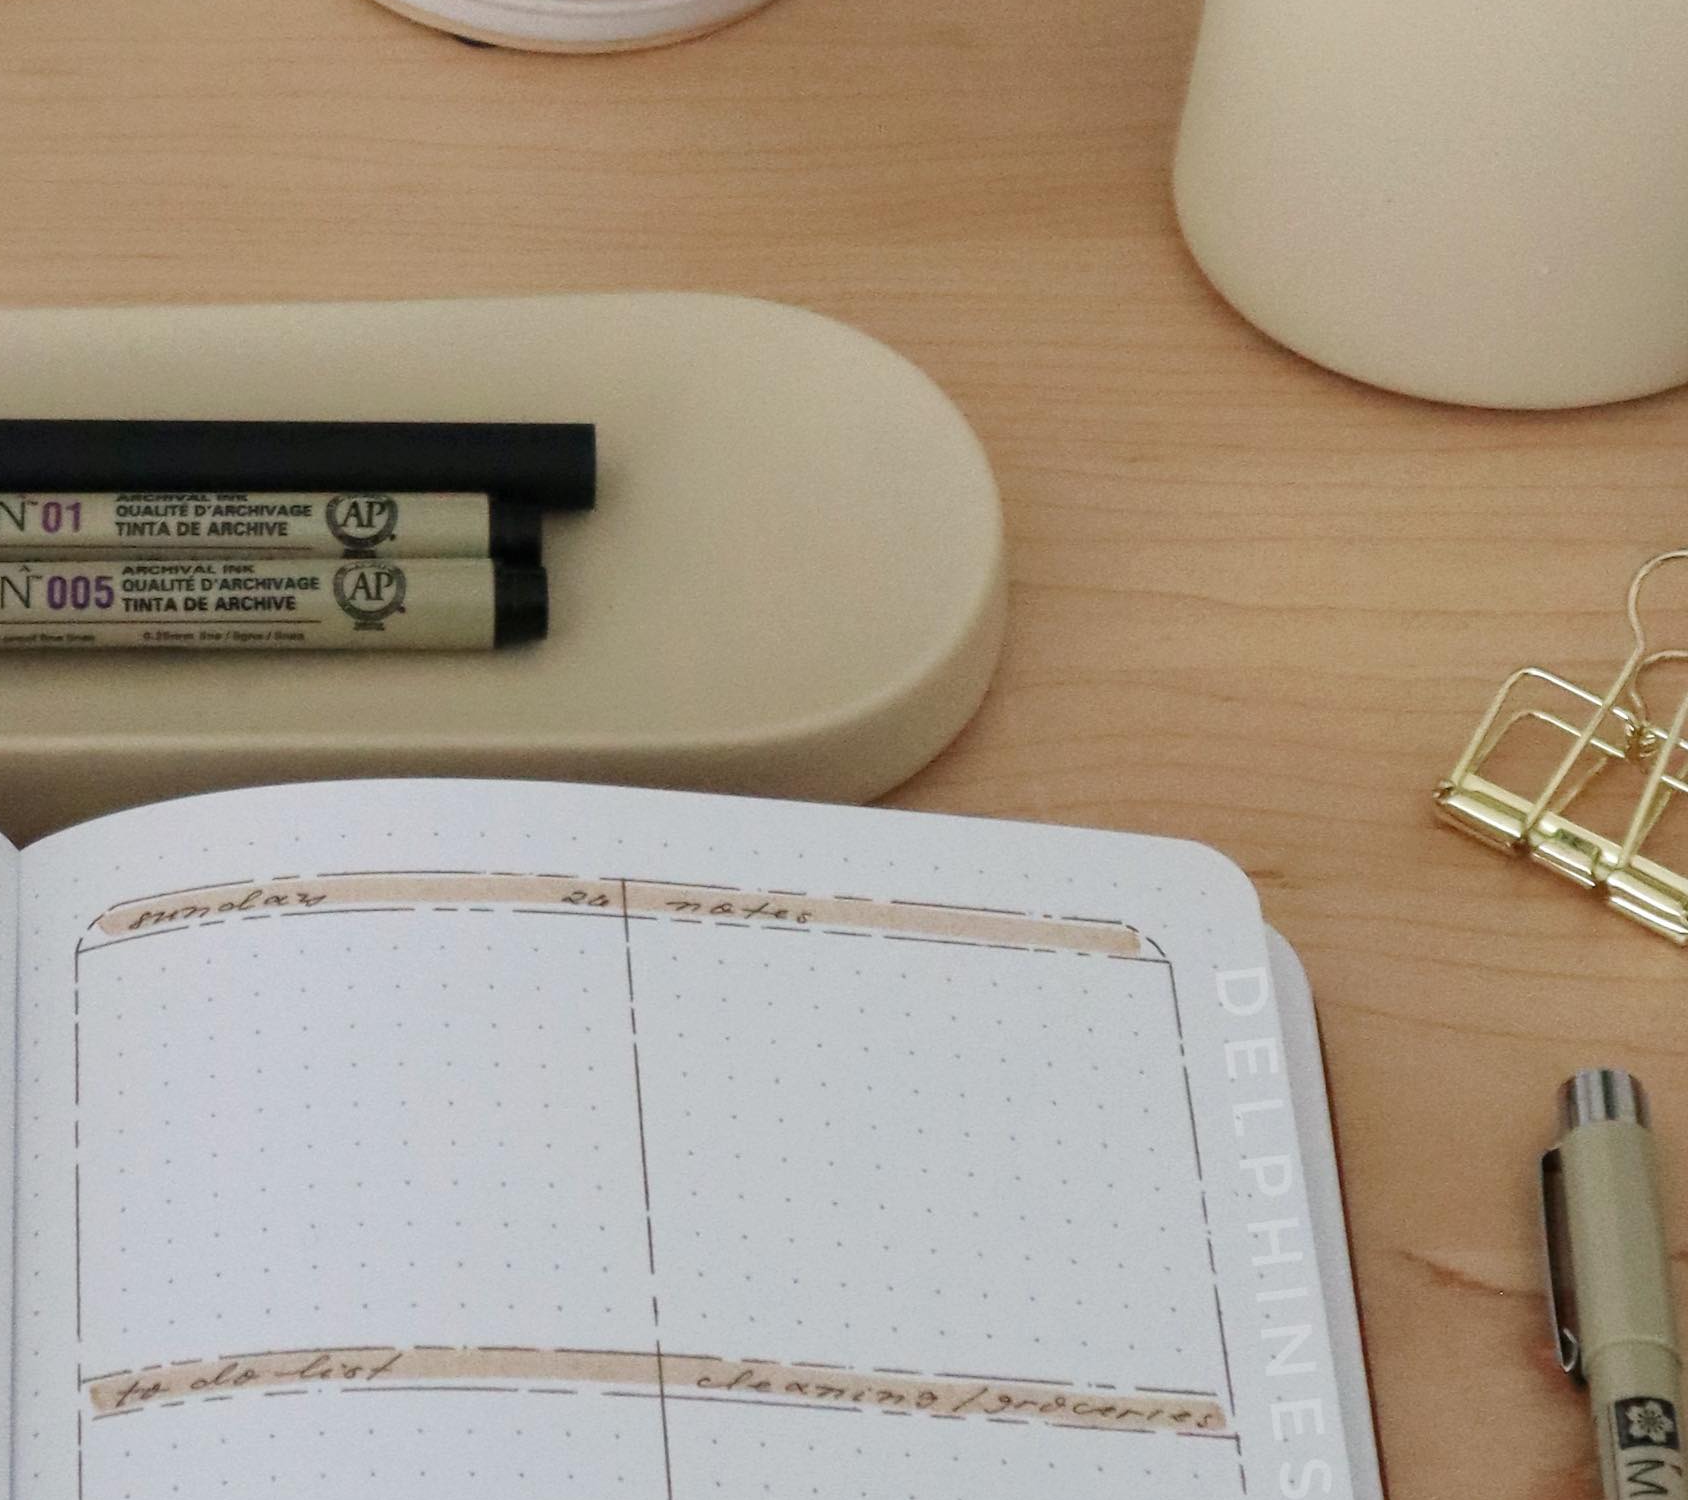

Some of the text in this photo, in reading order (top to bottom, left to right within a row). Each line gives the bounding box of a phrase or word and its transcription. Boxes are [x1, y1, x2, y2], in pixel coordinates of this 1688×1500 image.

[41, 501, 82, 534] 01
[115, 503, 312, 518] QUALITÉ D'ARCHIVAGE
[115, 521, 288, 537] TINTA DE ARCHIVE
[122, 565, 255, 575] ARCHIVAL INK
[47, 575, 114, 610] 005
[122, 575, 320, 592] QUALITÉ D'ARCHIVAGE
[122, 596, 297, 613] TINTA DE ARCHIVE
[128, 890, 328, 931] sunday
[666, 896, 813, 927] notes
[116, 1352, 403, 1409] to do list
